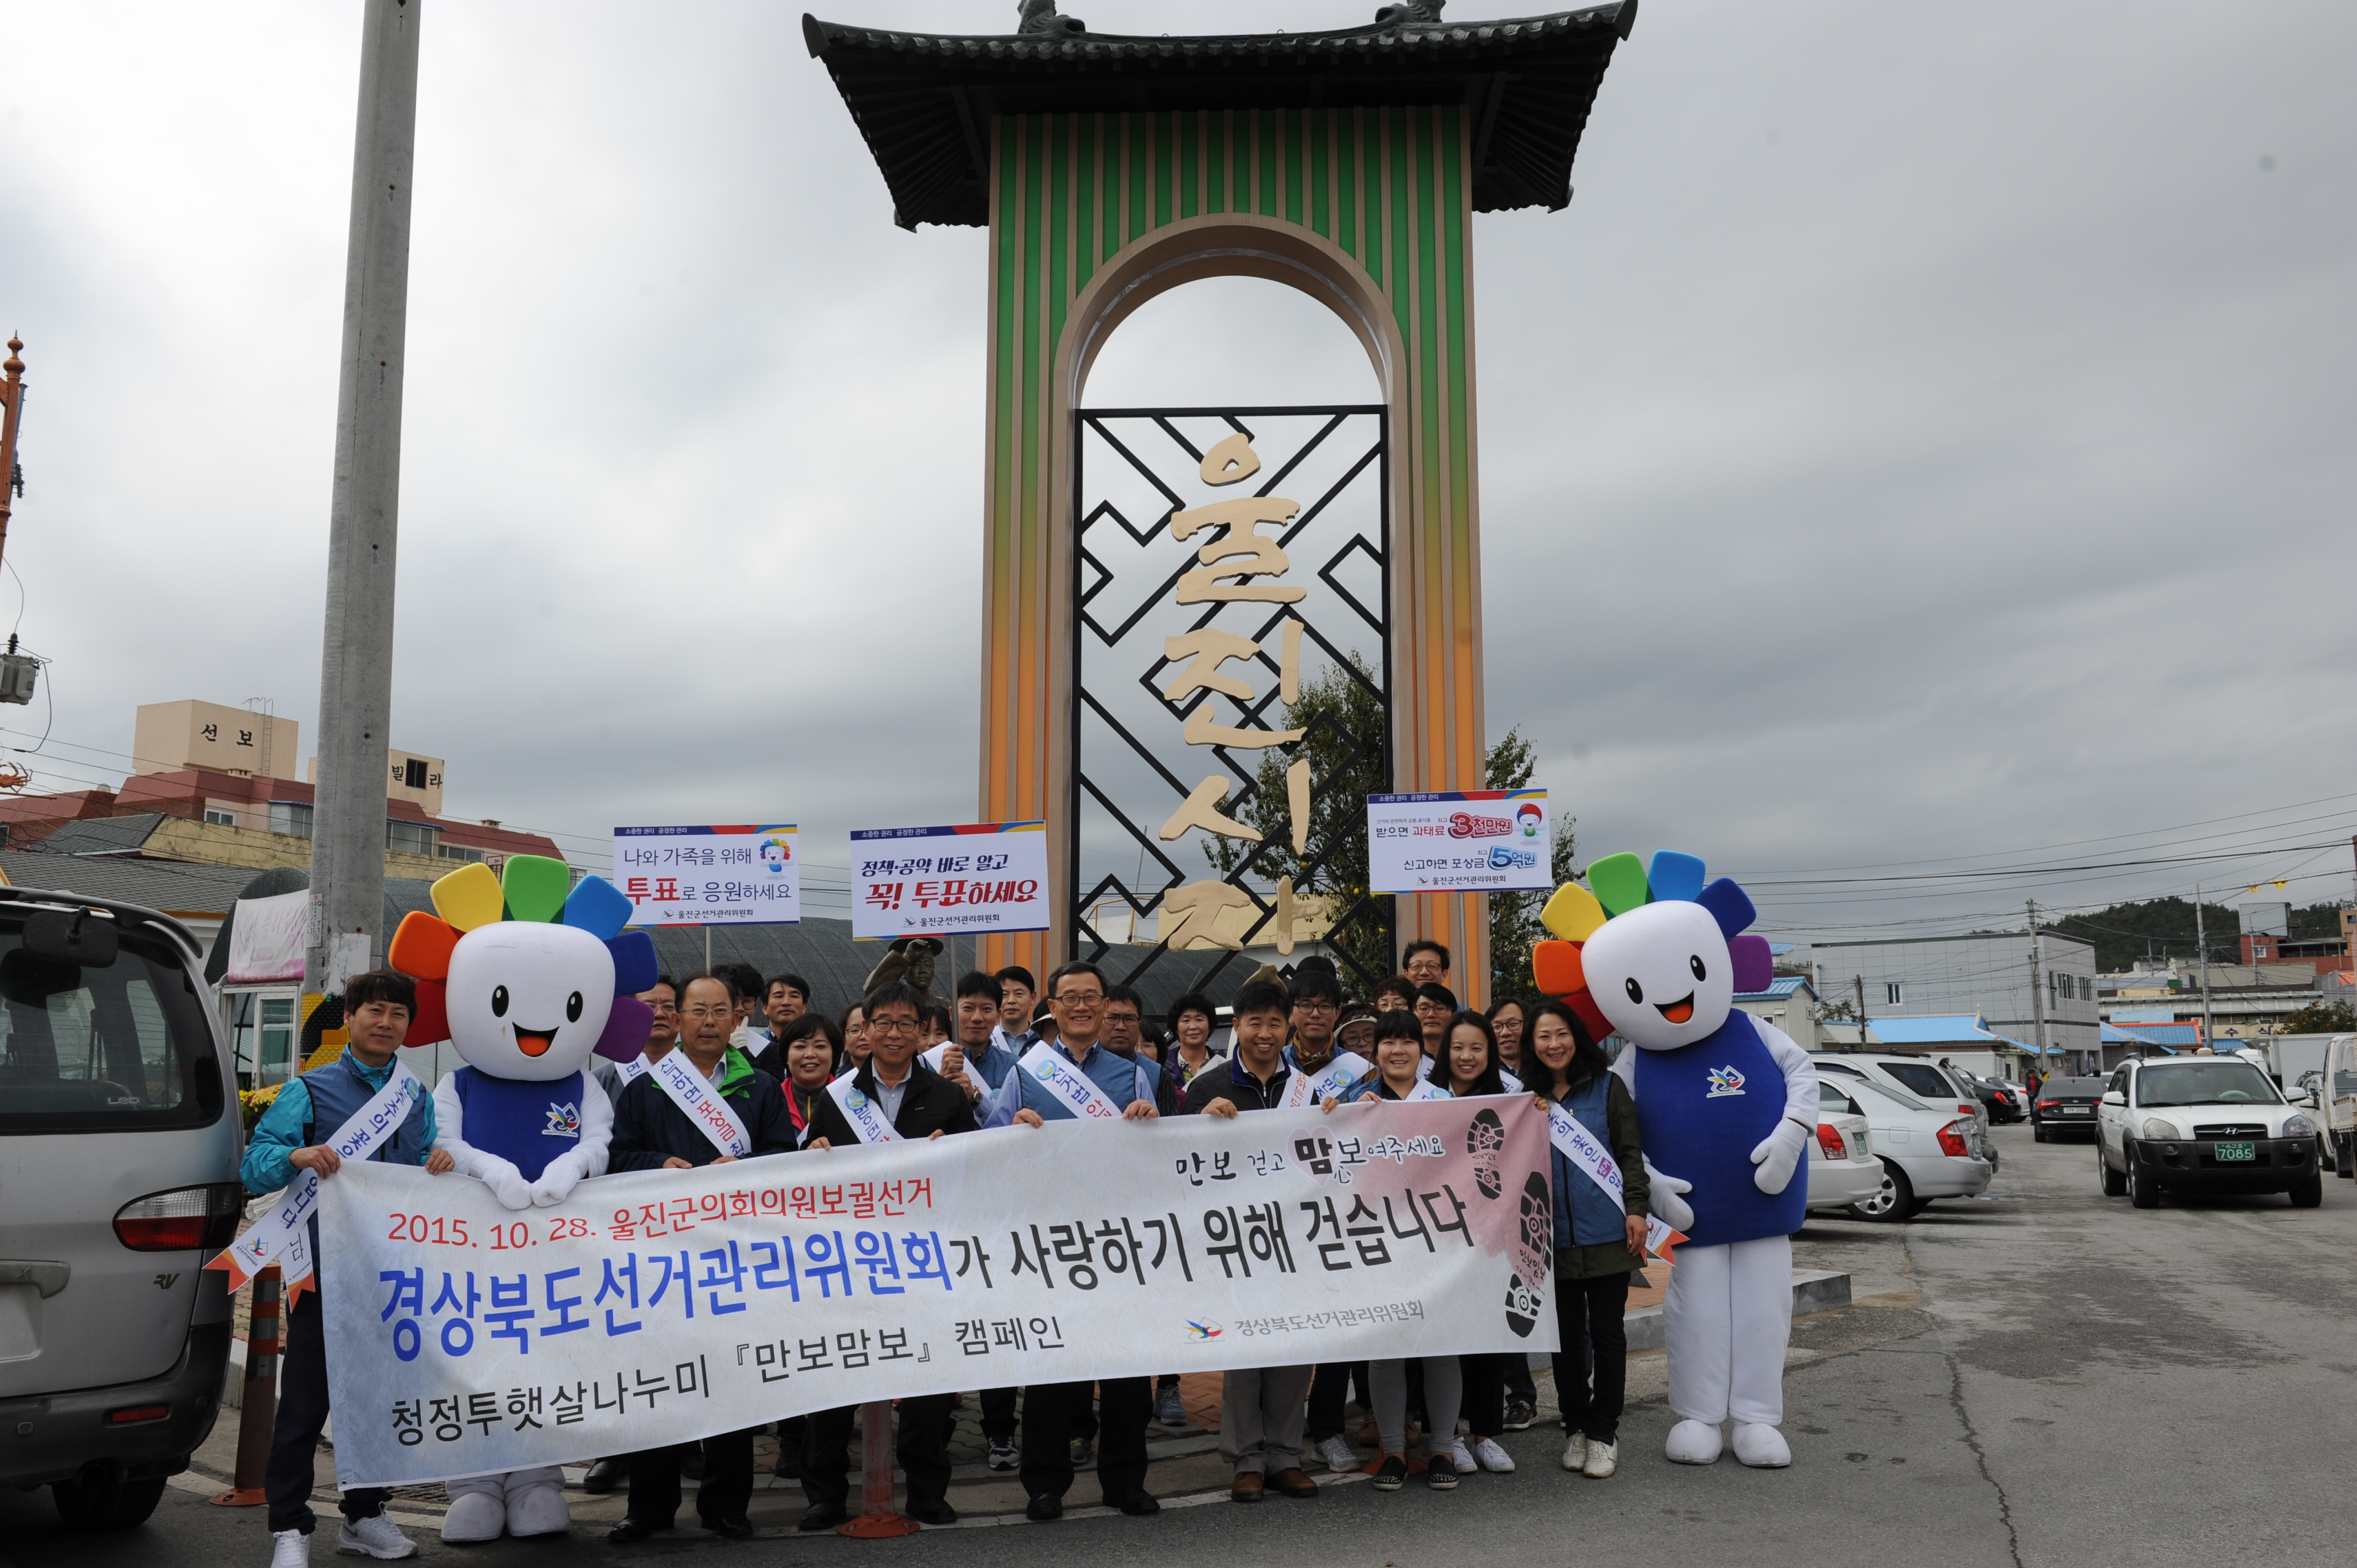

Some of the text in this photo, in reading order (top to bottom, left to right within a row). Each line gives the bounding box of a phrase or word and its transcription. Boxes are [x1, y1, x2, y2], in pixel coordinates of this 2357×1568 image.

[200, 723, 254, 747] 선보
[391, 765, 444, 790] 빌라
[896, 828, 914, 837] 공정한
[1376, 812, 1512, 838] 받으면 과태료 3천만원
[624, 847, 752, 867] 나와 가족을 위해
[860, 854, 1009, 878] 정책·공약 바로 알고
[1403, 847, 1536, 871] 신고하면 포상금 5억원
[624, 877, 792, 906] 투표로 응원하세요
[1432, 874, 1506, 885] 울진군선거관리위원회
[864, 879, 1039, 911] 꼭! 투표하세요
[677, 909, 754, 920] 울진군선거관리위원회
[919, 913, 1000, 927] 울진군선거관리위원회
[1052, 1067, 1091, 1105] 선거법
[661, 1058, 746, 1157] 신고하면 포상금 최
[1176, 1135, 1446, 1187] 만보 걷고 맘보여주세요
[1570, 1134, 1601, 1163] 꽃은
[2218, 1148, 2252, 1159] 7085
[388, 1177, 933, 1250] 2015. 10. 28. 울진군의회의원보궐선거
[153, 1273, 181, 1290] RV
[380, 1184, 1475, 1362] 경상북도선거관리위원회가 사랑하기 위해 걷습니다
[1234, 1299, 1425, 1338] 경상북도선거관리위원회
[392, 1316, 1065, 1446] 청정투햇살나누미 『만보맘보』 캠페인
